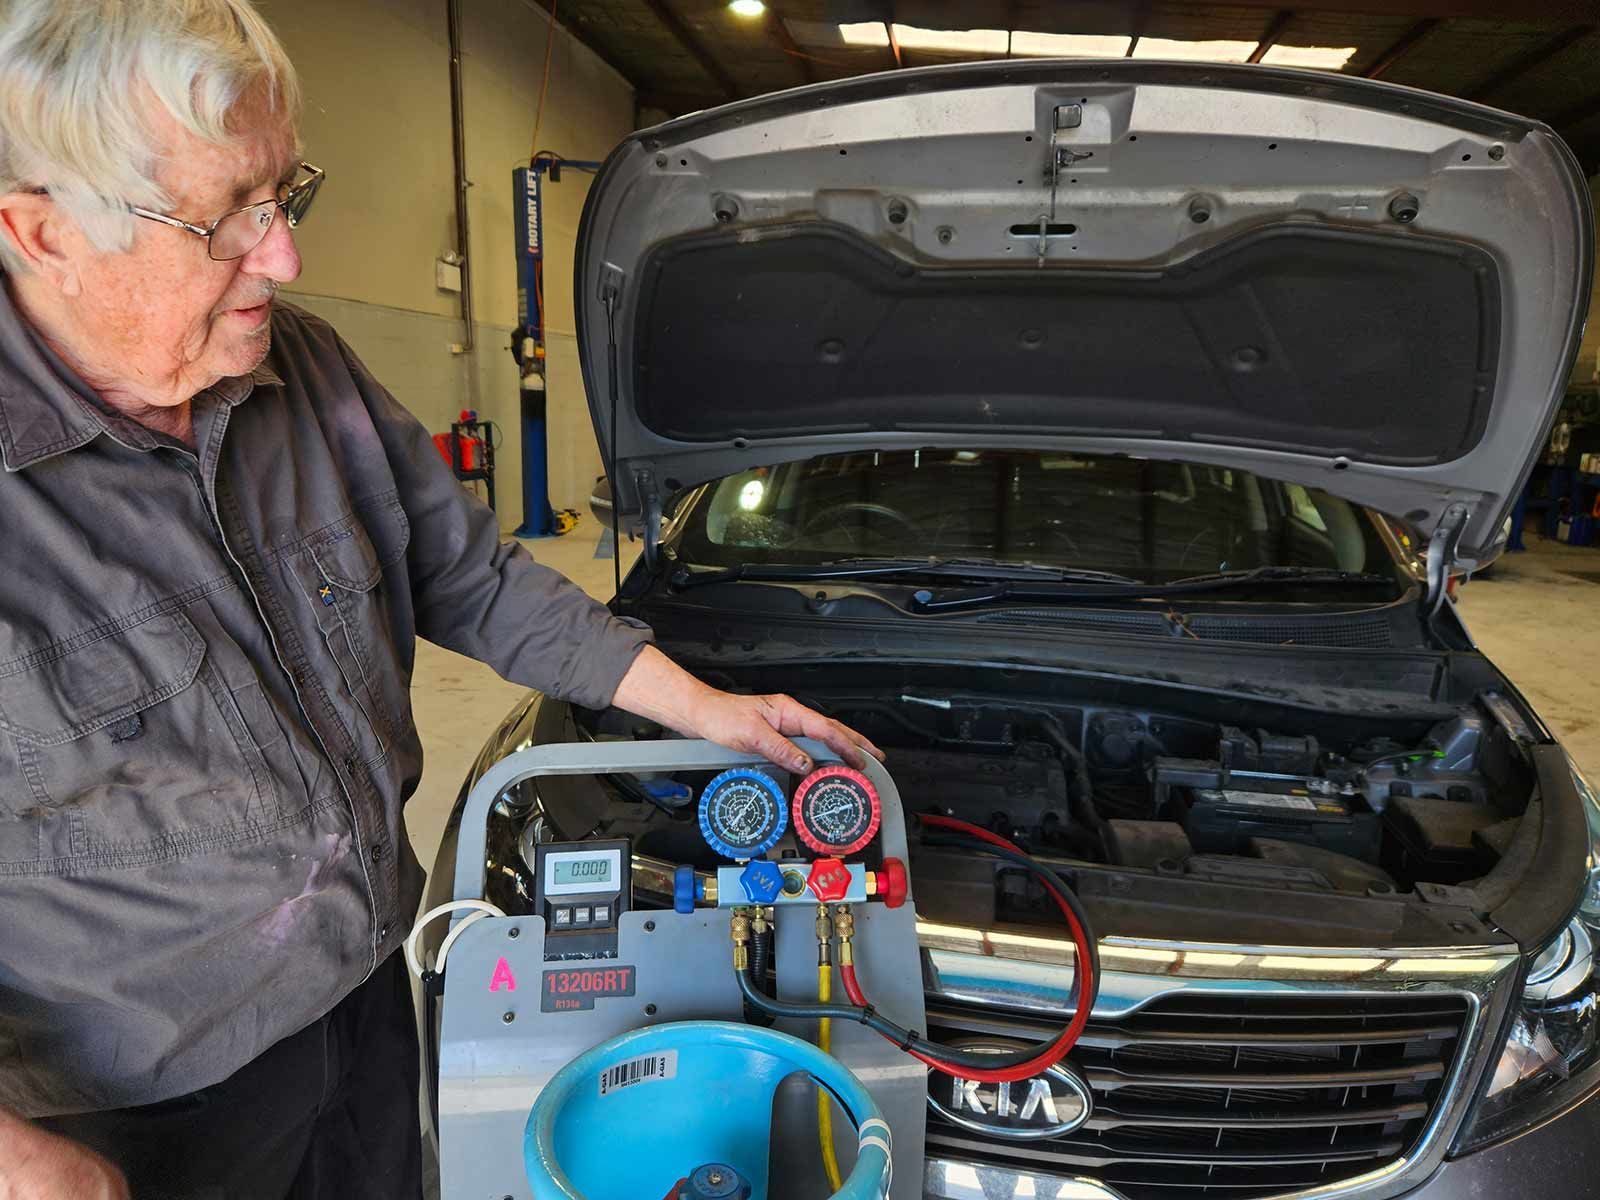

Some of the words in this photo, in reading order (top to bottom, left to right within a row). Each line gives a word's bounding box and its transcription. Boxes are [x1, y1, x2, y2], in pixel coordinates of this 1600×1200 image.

[527, 169, 537, 196] LIFT
[527, 200, 539, 247] ROTARY
[571, 861, 607, 877] 0.000
[488, 956, 517, 993] A
[547, 968, 631, 993] 13206RT
[952, 1075, 1059, 1124] KIA
